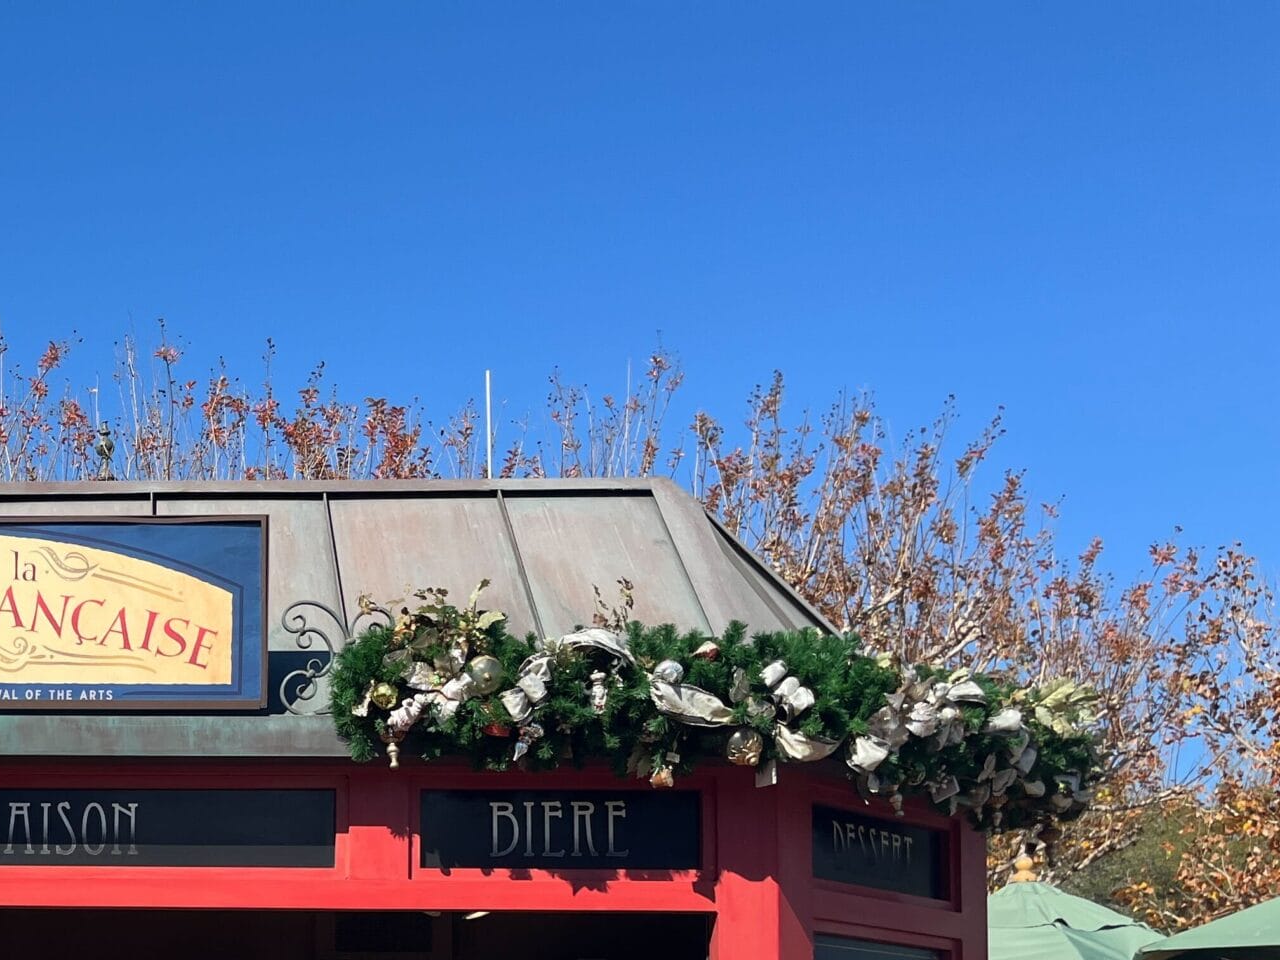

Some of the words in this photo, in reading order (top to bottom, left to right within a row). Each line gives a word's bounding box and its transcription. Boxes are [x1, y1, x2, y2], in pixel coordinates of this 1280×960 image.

[10, 549, 38, 582] la
[24, 689, 42, 700] OF
[48, 689, 73, 700] THE
[79, 689, 114, 700] ARTS
[489, 800, 630, 857] BIERE
[832, 819, 914, 864] DESSERT
